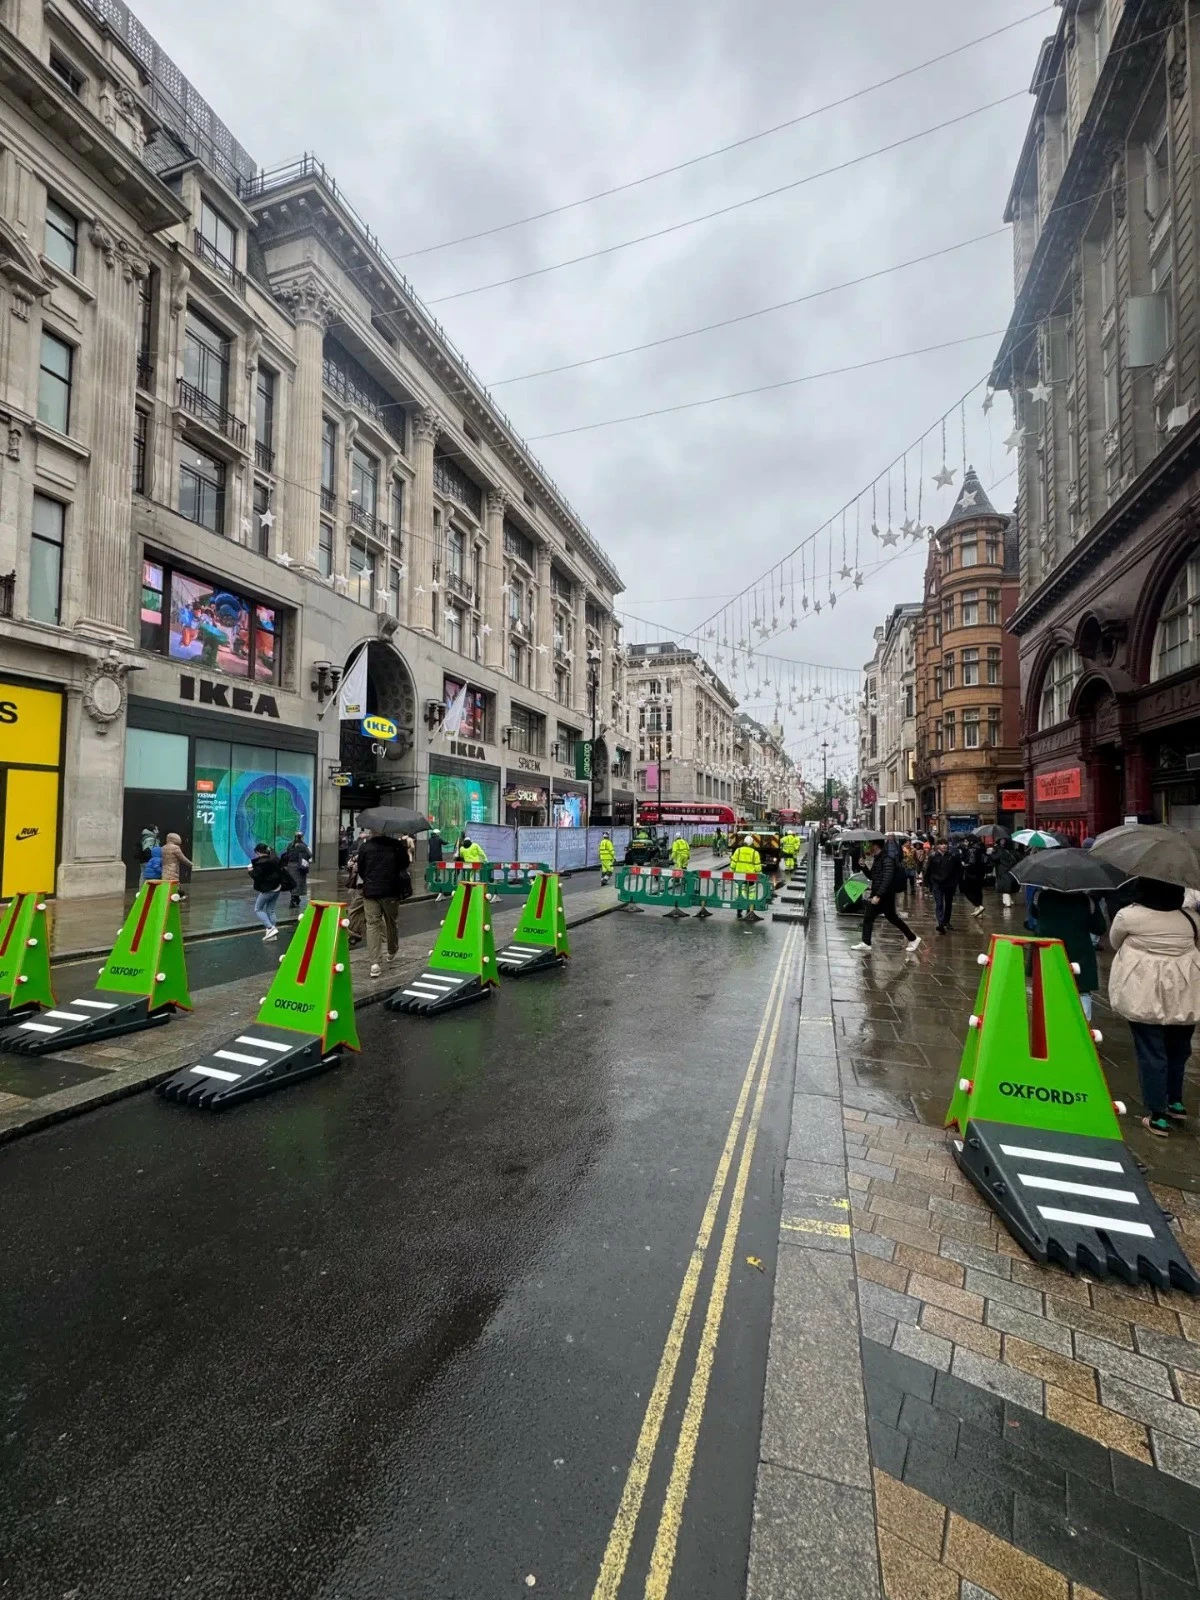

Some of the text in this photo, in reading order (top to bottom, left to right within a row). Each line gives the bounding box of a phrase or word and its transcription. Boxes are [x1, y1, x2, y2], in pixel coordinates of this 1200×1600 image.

[180, 675, 280, 718] IKEA
[366, 721, 394, 734] IKEA
[371, 743, 387, 758] City
[450, 741, 485, 760] IKEA
[197, 811, 216, 824] £12
[21, 827, 39, 835] RUN
[523, 927, 544, 935] OXFORD
[441, 949, 468, 960] OXFORD
[110, 966, 138, 977] OXFORD
[274, 998, 309, 1013] OXFORD
[999, 1081, 1075, 1105] OXFORD
